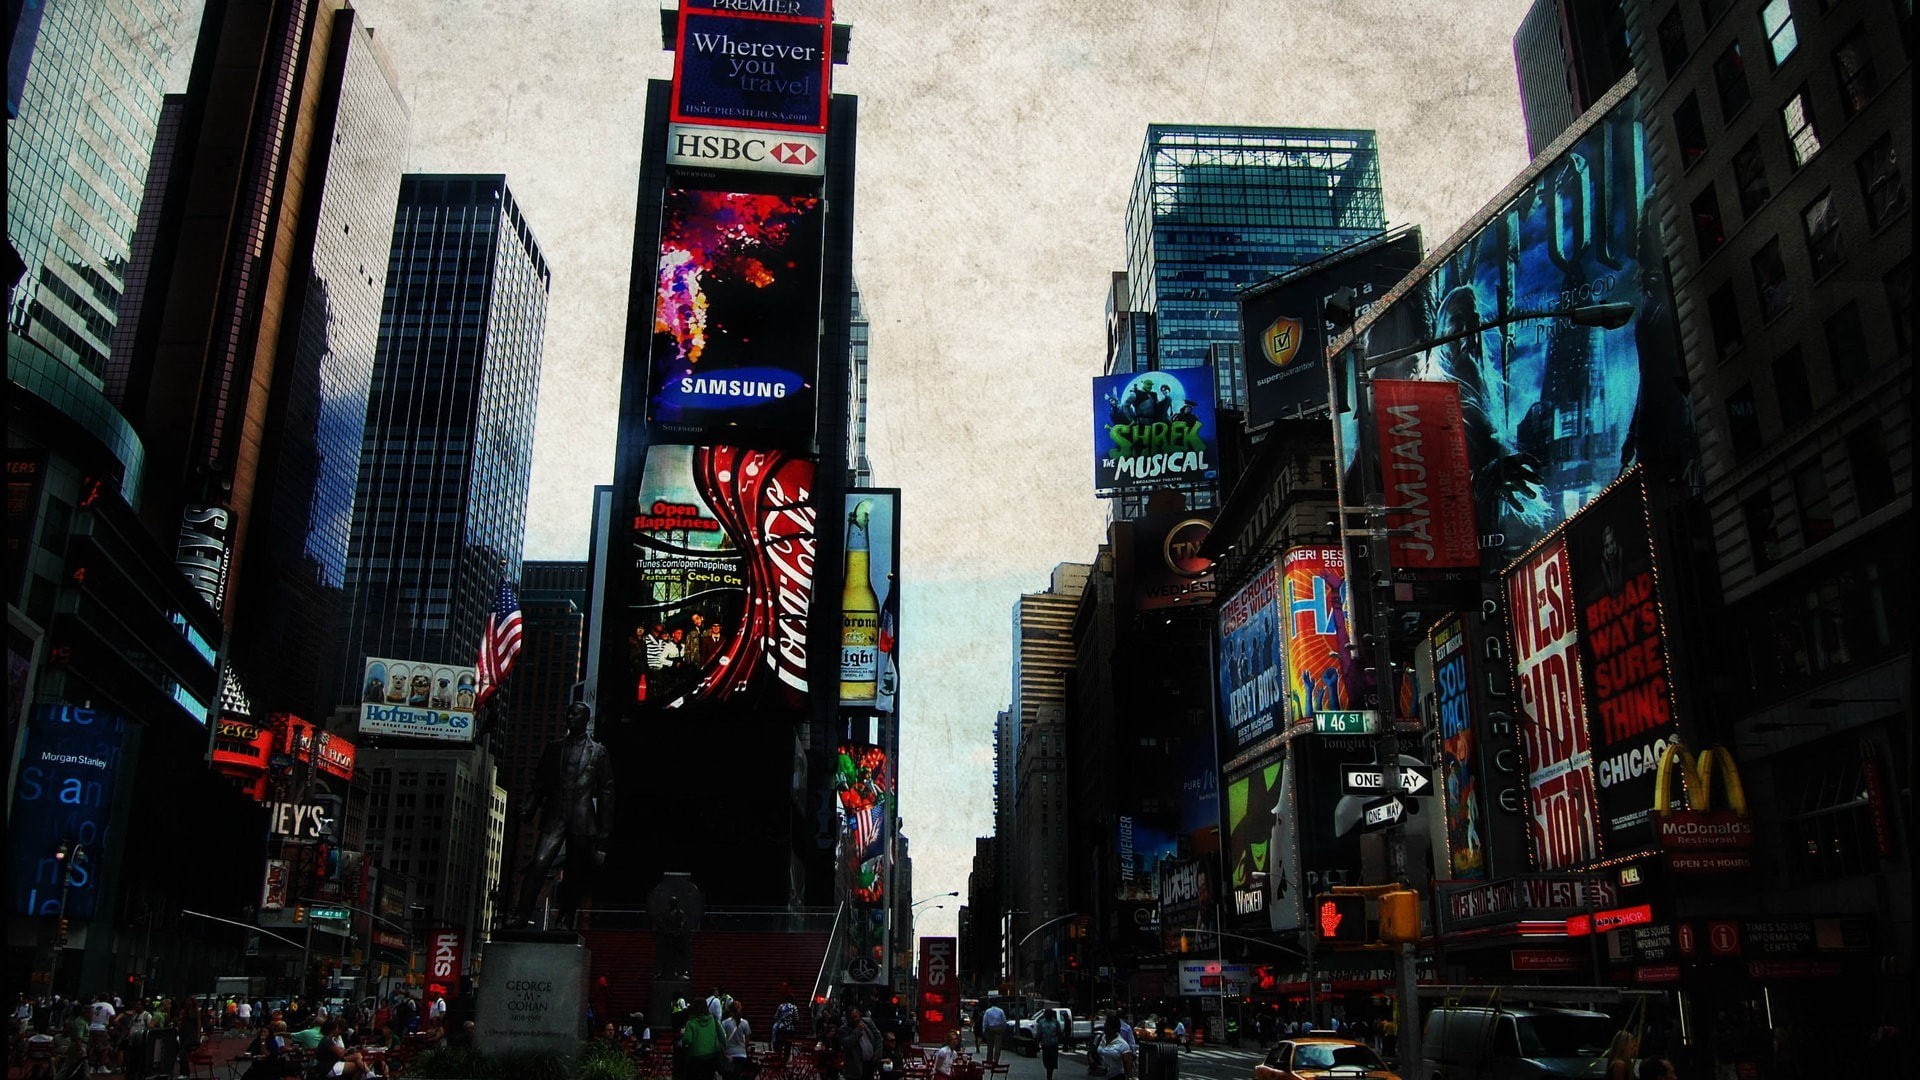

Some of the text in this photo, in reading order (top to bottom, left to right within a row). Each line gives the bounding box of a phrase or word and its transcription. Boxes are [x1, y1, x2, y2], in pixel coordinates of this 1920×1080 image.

[693, 32, 815, 61] Wherever
[729, 57, 776, 77] you
[740, 75, 810, 95] travel
[675, 134, 765, 162] HSBC
[681, 376, 786, 399] SAMSUNG
[1104, 420, 1207, 458] SHREK
[1102, 451, 1208, 480] THE MUSICAL
[1387, 404, 1435, 561] JAMJAM
[653, 501, 698, 518] Open
[633, 514, 719, 531] Happiness
[636, 558, 737, 572] iTunes.com/openhappiness
[641, 572, 681, 583] Featuring
[1222, 566, 1276, 621] THE CROWD
[1585, 571, 1655, 632] BROAD
[1223, 608, 1248, 637] GOES
[1589, 600, 1659, 661] WAY'S
[1593, 634, 1663, 699] SURE
[1229, 663, 1281, 729] JERSEY BOYS
[366, 704, 416, 724] HOTEL
[1599, 675, 1672, 746] THING
[1316, 713, 1360, 732] W 46 ST
[40, 749, 105, 768] Morgan Stanley
[1355, 774, 1419, 787] ONE AY
[1368, 802, 1400, 823] ONE WAY
[1663, 822, 1751, 835] McDonald's
[1120, 815, 1134, 881] THE AVENGER
[1678, 836, 1737, 845] Restaurant
[1673, 858, 1751, 869] OPEN 24 HOURS
[1621, 867, 1640, 885] FUEL
[1235, 889, 1263, 916] WICKED
[1616, 911, 1644, 923] SHOP
[1635, 926, 1672, 939] TIMES SQUARE
[1745, 923, 1773, 932] TIMES
[1748, 932, 1810, 943] INFORMATION
[434, 933, 459, 978] tkts
[1644, 948, 1665, 960] CENTER
[1763, 943, 1799, 952] CENTER
[928, 942, 950, 986] tkts
[506, 980, 553, 992] GEORGE
[508, 1001, 548, 1011] COHAN
[523, 992, 535, 1001] M
